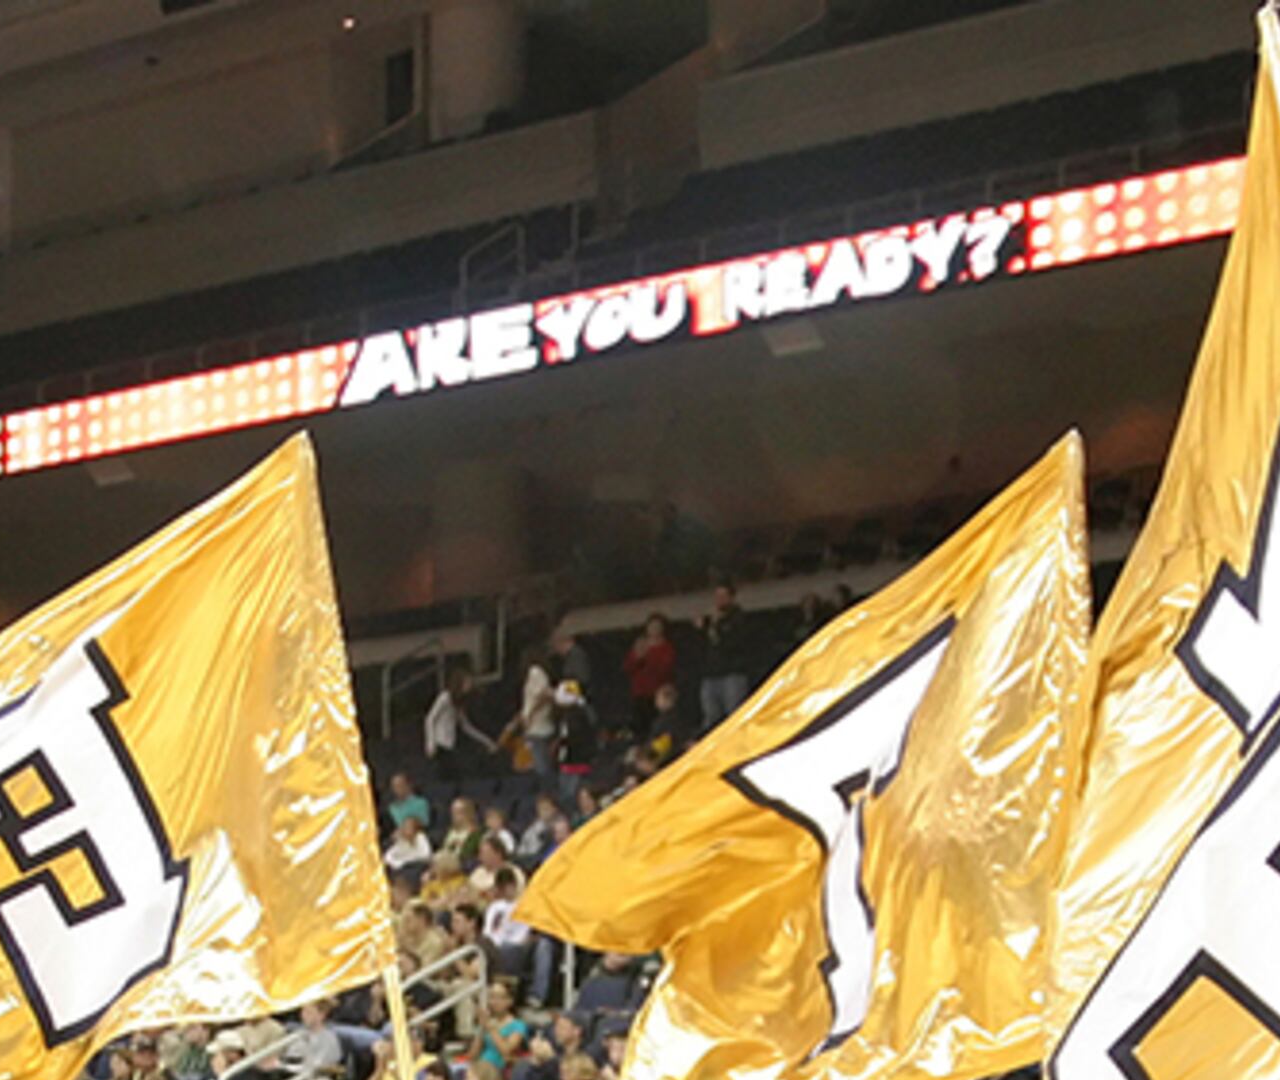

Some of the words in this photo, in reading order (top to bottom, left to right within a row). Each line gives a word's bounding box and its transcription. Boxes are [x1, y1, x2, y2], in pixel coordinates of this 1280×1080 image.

[339, 302, 538, 407] ARE
[536, 283, 688, 361] YOU
[723, 212, 1013, 321] READY?
